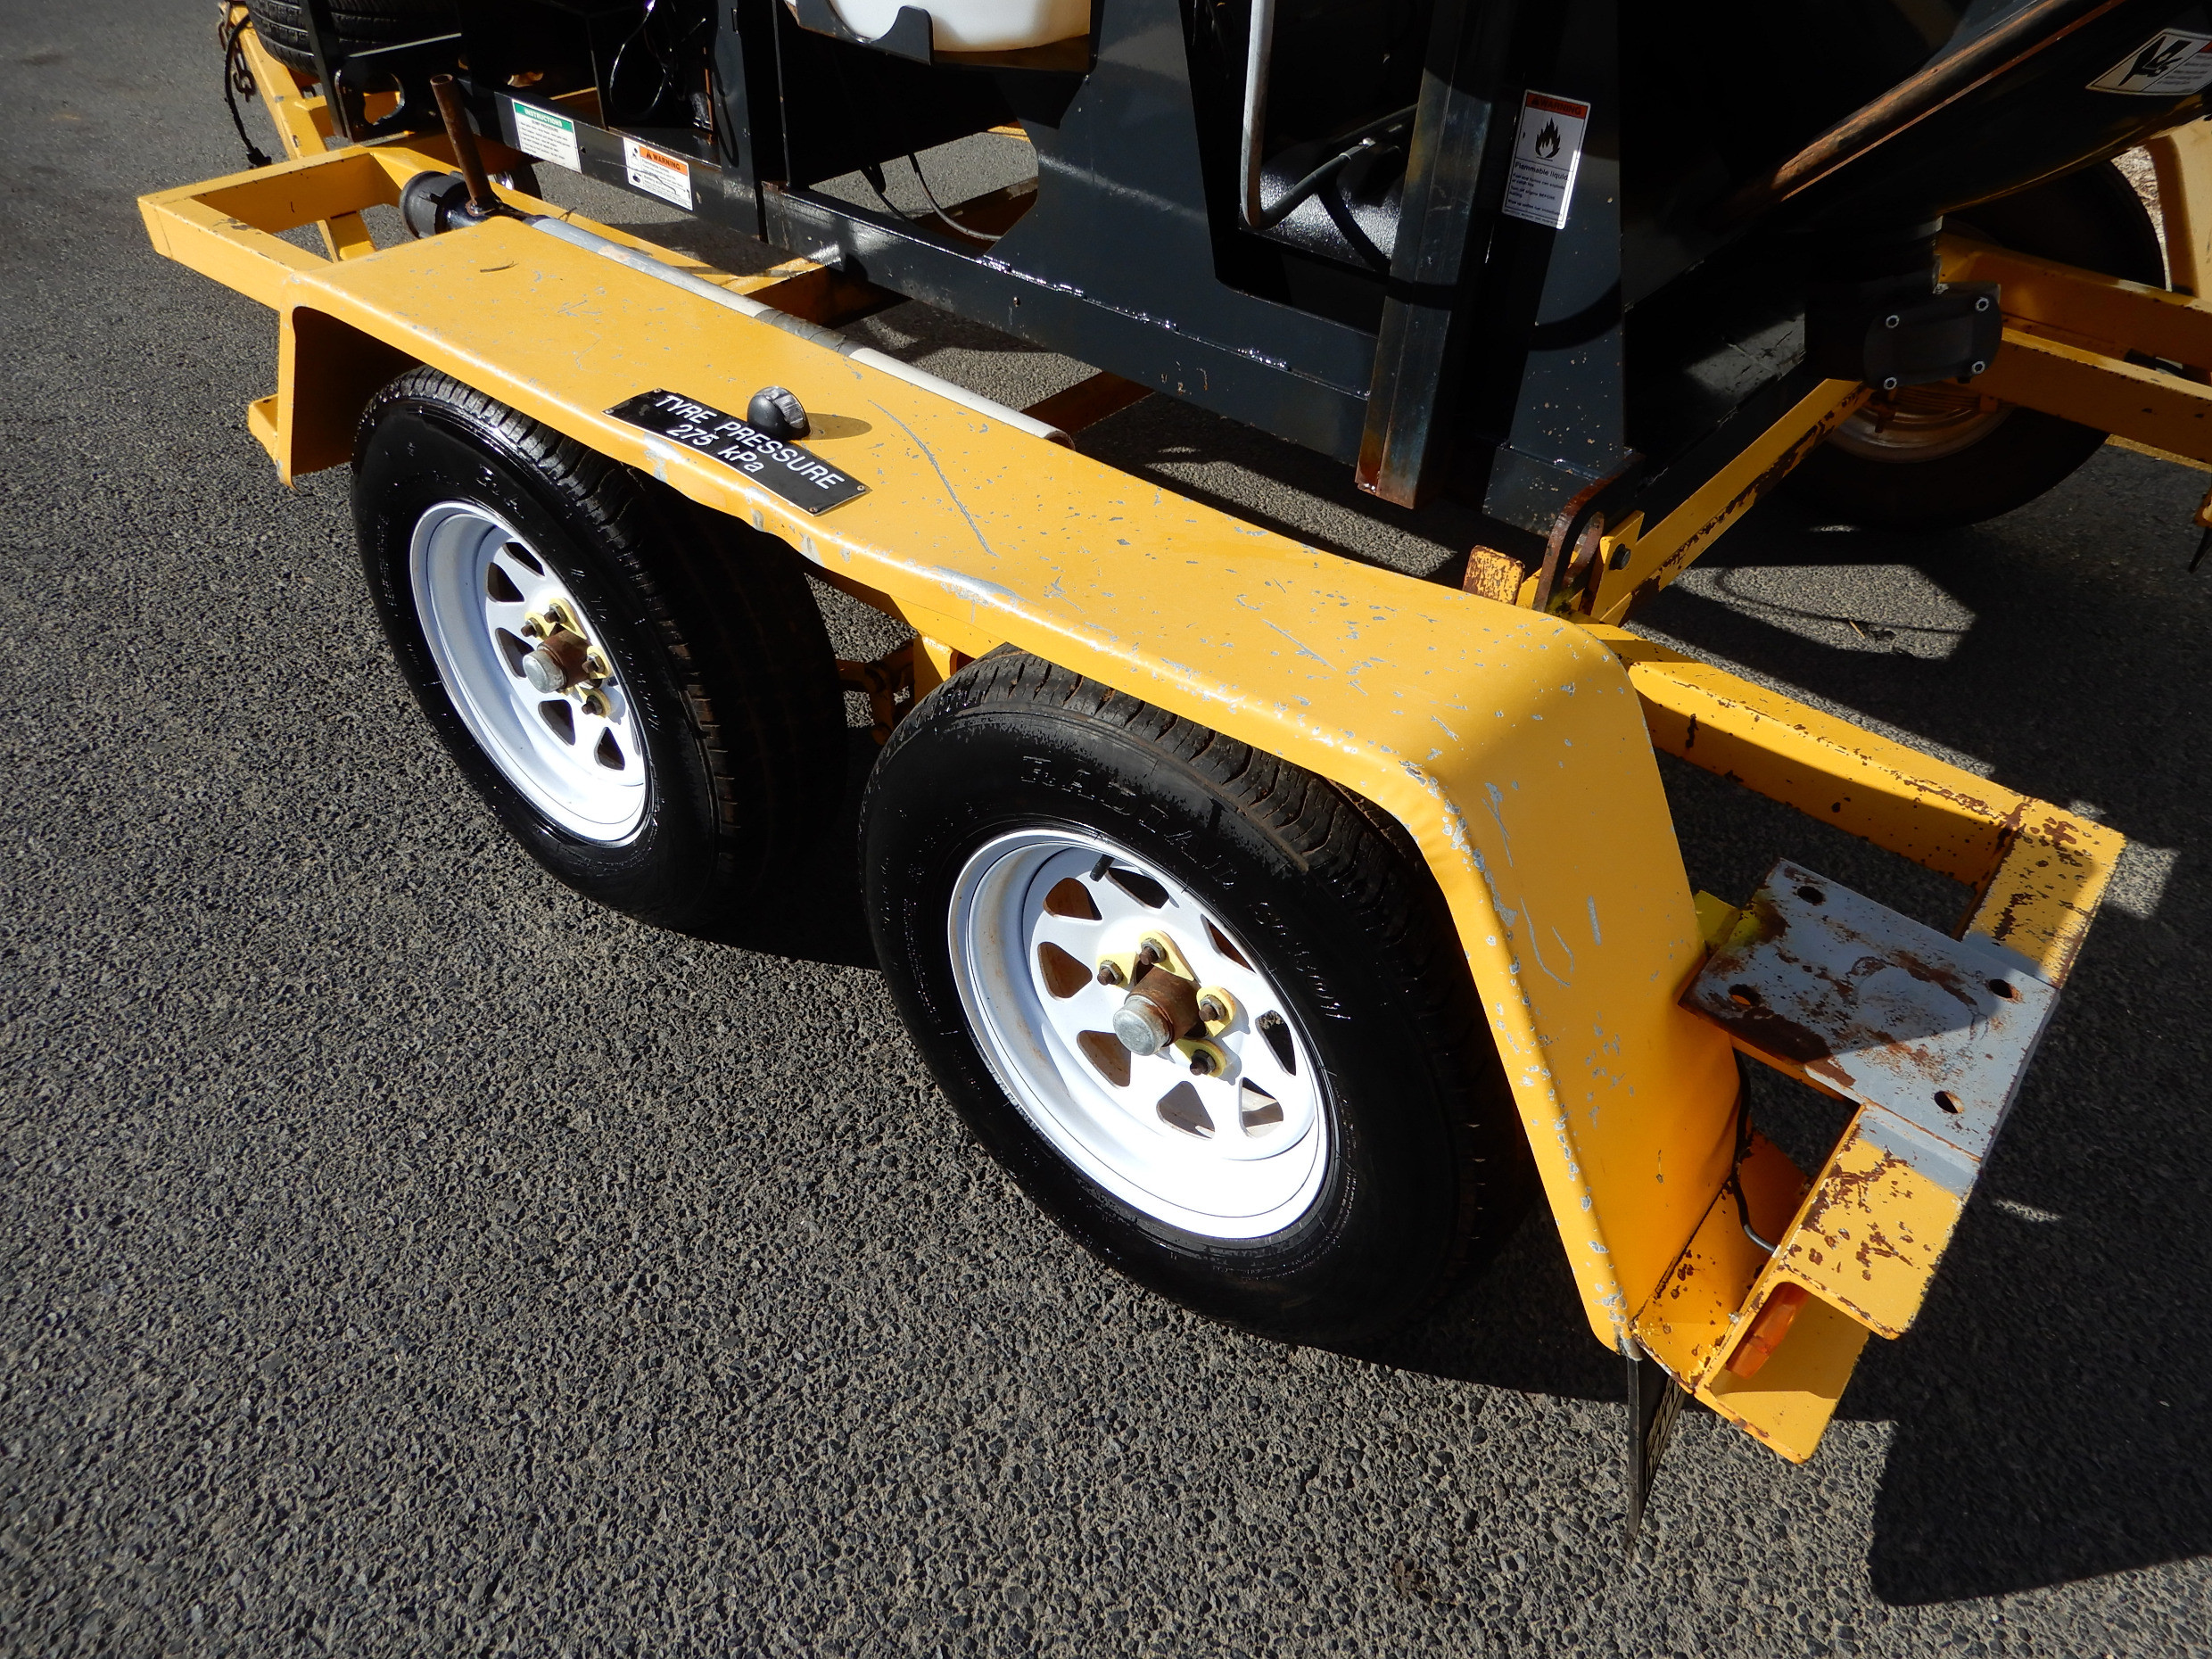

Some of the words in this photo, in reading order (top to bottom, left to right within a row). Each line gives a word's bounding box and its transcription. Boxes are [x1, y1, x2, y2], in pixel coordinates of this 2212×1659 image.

[1539, 97, 1582, 116] WARNING
[524, 107, 564, 128] INSTRUCTIONS
[652, 153, 681, 171] WARNING
[1515, 161, 1549, 177] Flammable
[1549, 170, 1569, 181] liquid
[655, 393, 718, 425] TYRE
[713, 420, 846, 491] PRESSURE
[665, 423, 720, 447] 275
[717, 445, 765, 474] kPa
